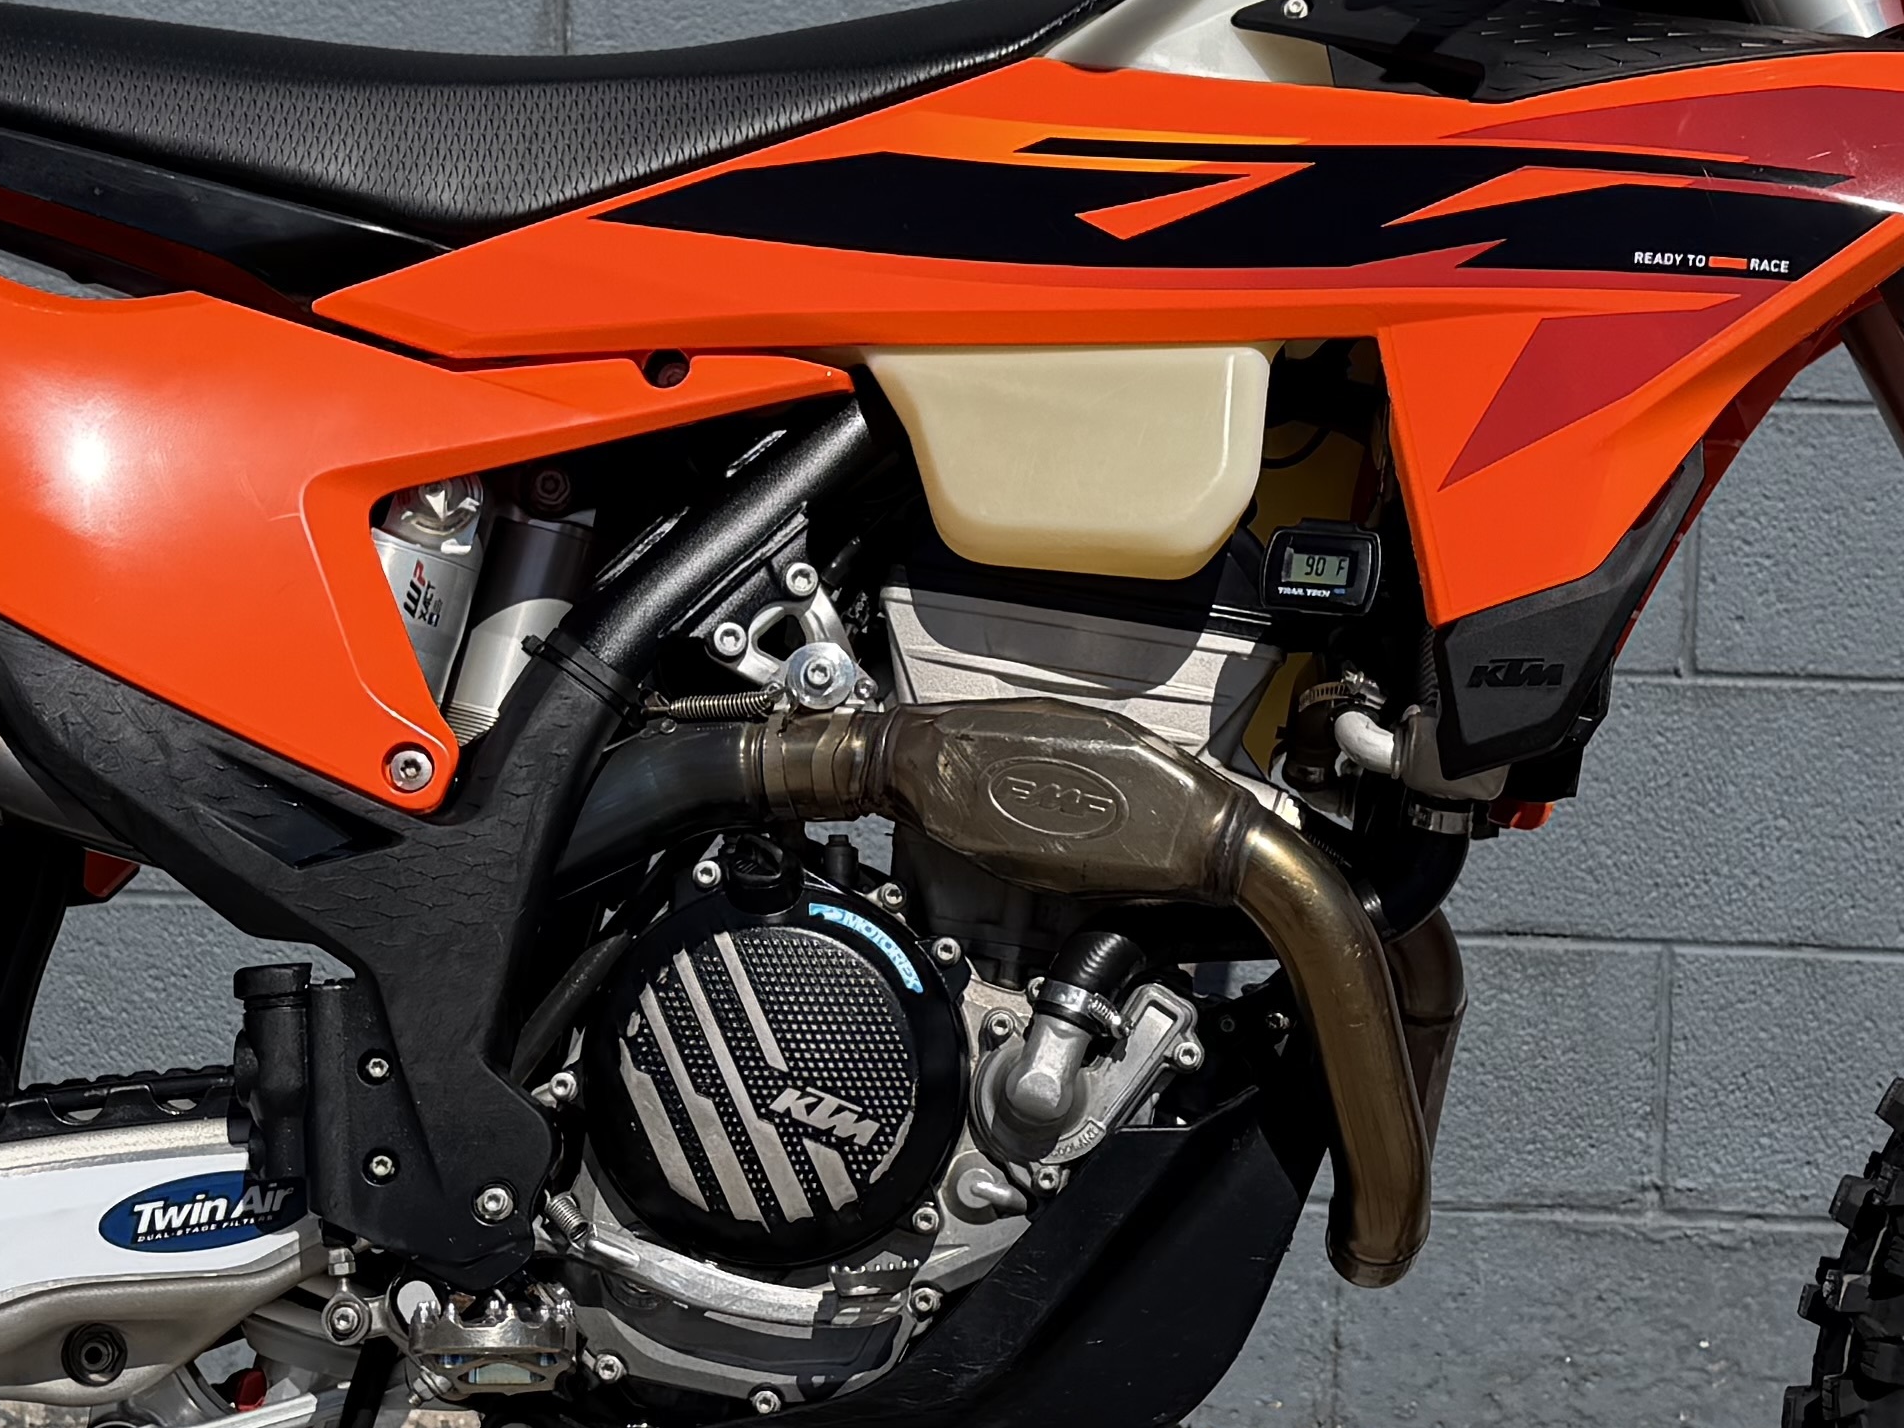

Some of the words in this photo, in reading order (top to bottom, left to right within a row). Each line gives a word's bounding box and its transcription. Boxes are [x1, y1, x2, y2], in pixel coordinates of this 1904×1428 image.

[1633, 251, 1684, 266] READY
[1687, 254, 1706, 268] TO
[1749, 258, 1790, 273] RACE
[1304, 555, 1326, 577] 90
[1336, 557, 1347, 577] F
[1278, 586, 1305, 597] TRAIL
[1465, 657, 1565, 689] KTM
[994, 775, 1114, 819] FMF
[842, 911, 923, 993] MOTOREX
[771, 1088, 879, 1148] KTM
[133, 1193, 228, 1234] Twin
[230, 1183, 293, 1219] Air
